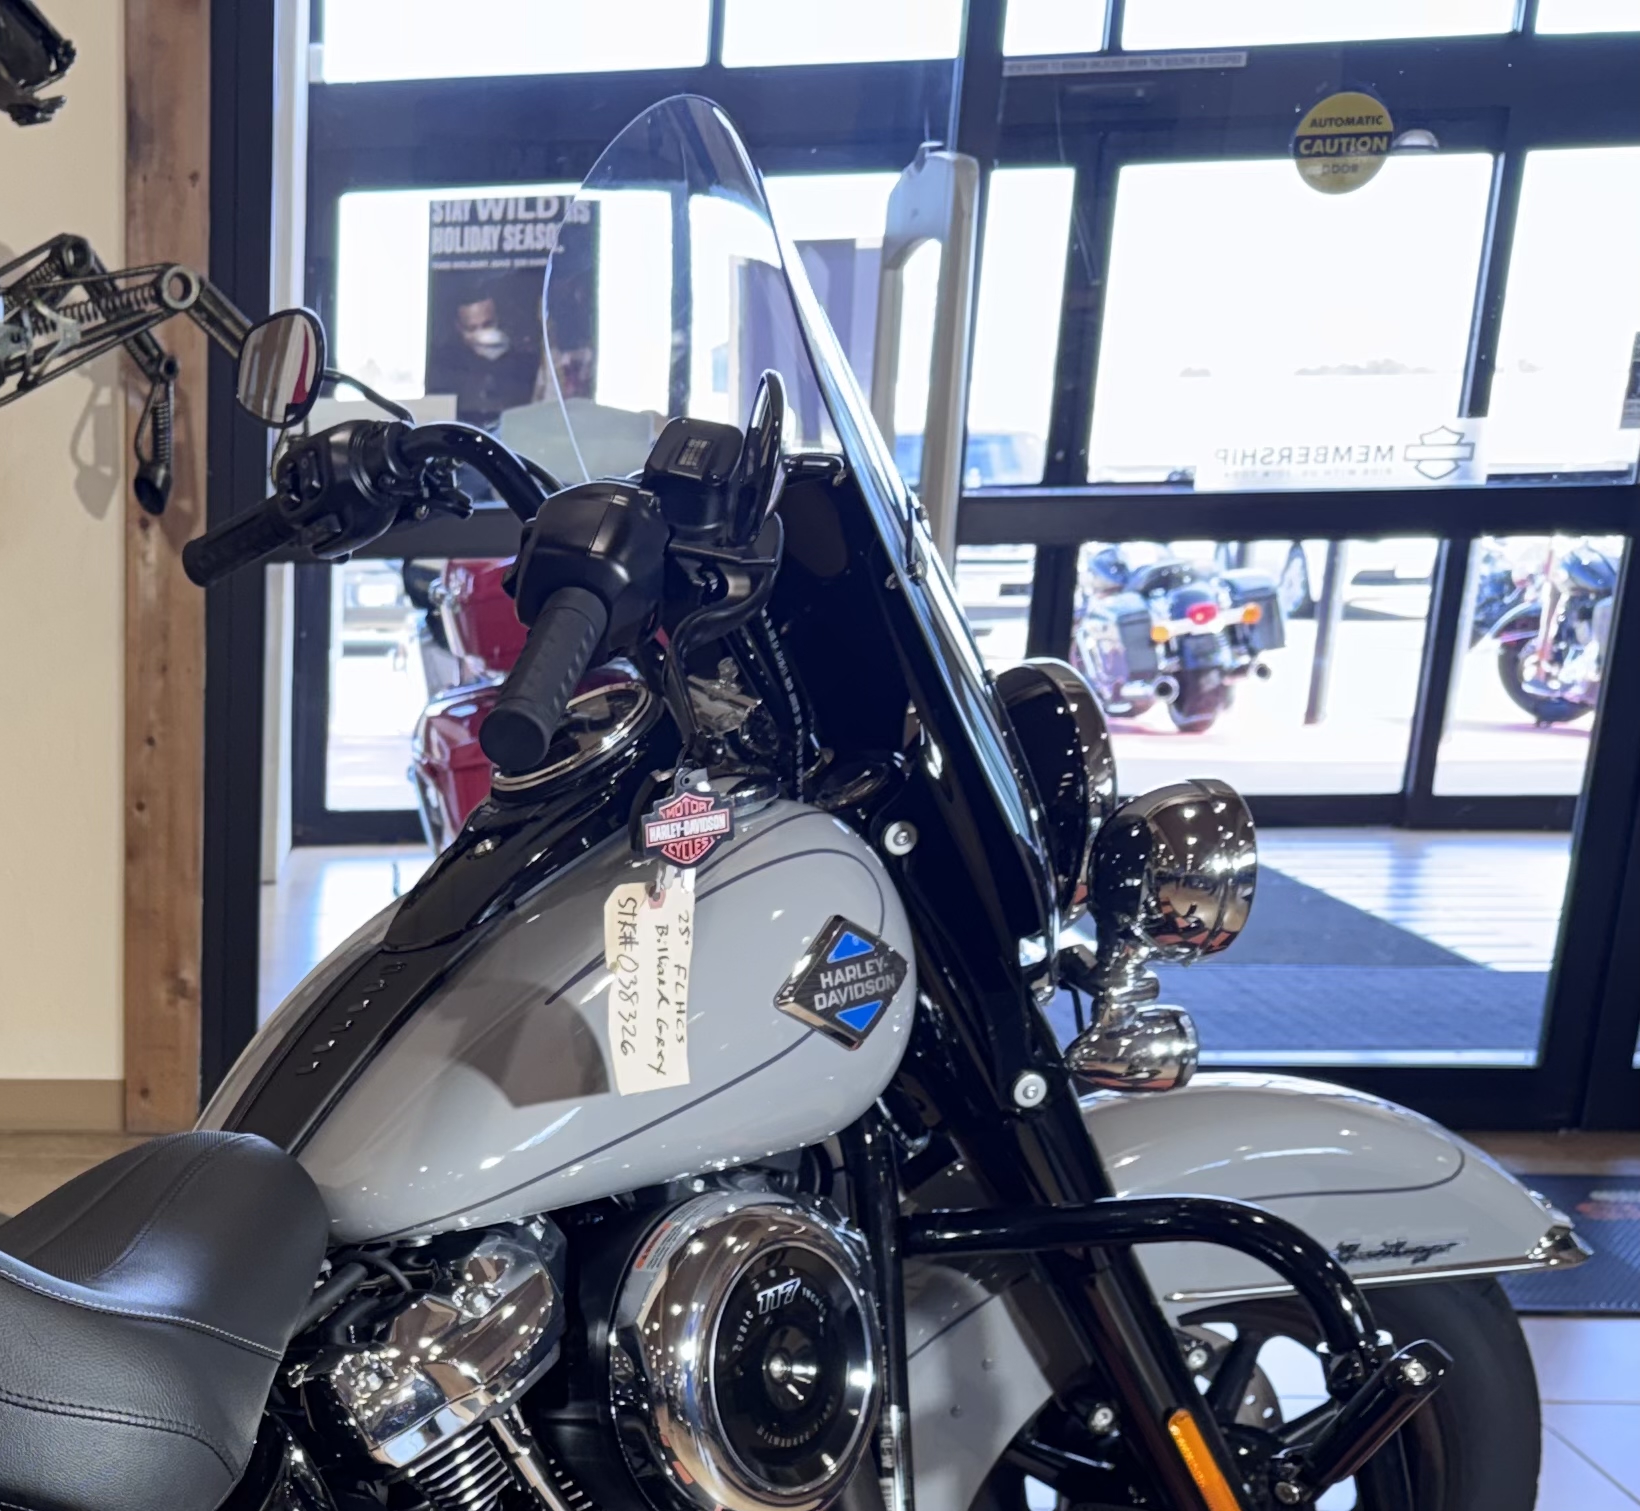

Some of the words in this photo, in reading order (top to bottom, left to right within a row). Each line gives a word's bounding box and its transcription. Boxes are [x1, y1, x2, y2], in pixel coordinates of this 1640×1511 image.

[1310, 115, 1384, 128] AUTOMATIC
[1300, 136, 1388, 155] CAUTION
[475, 197, 560, 221] WILD
[432, 225, 502, 254] HOLIDAY
[666, 797, 708, 819] MOTOR
[649, 813, 726, 842] HARLEY-DAVIDSON
[668, 837, 709, 860] CYCLES
[820, 956, 888, 989] HARLEY-
[814, 973, 895, 1011] DAVIDSON
[757, 1277, 801, 1315] 117
